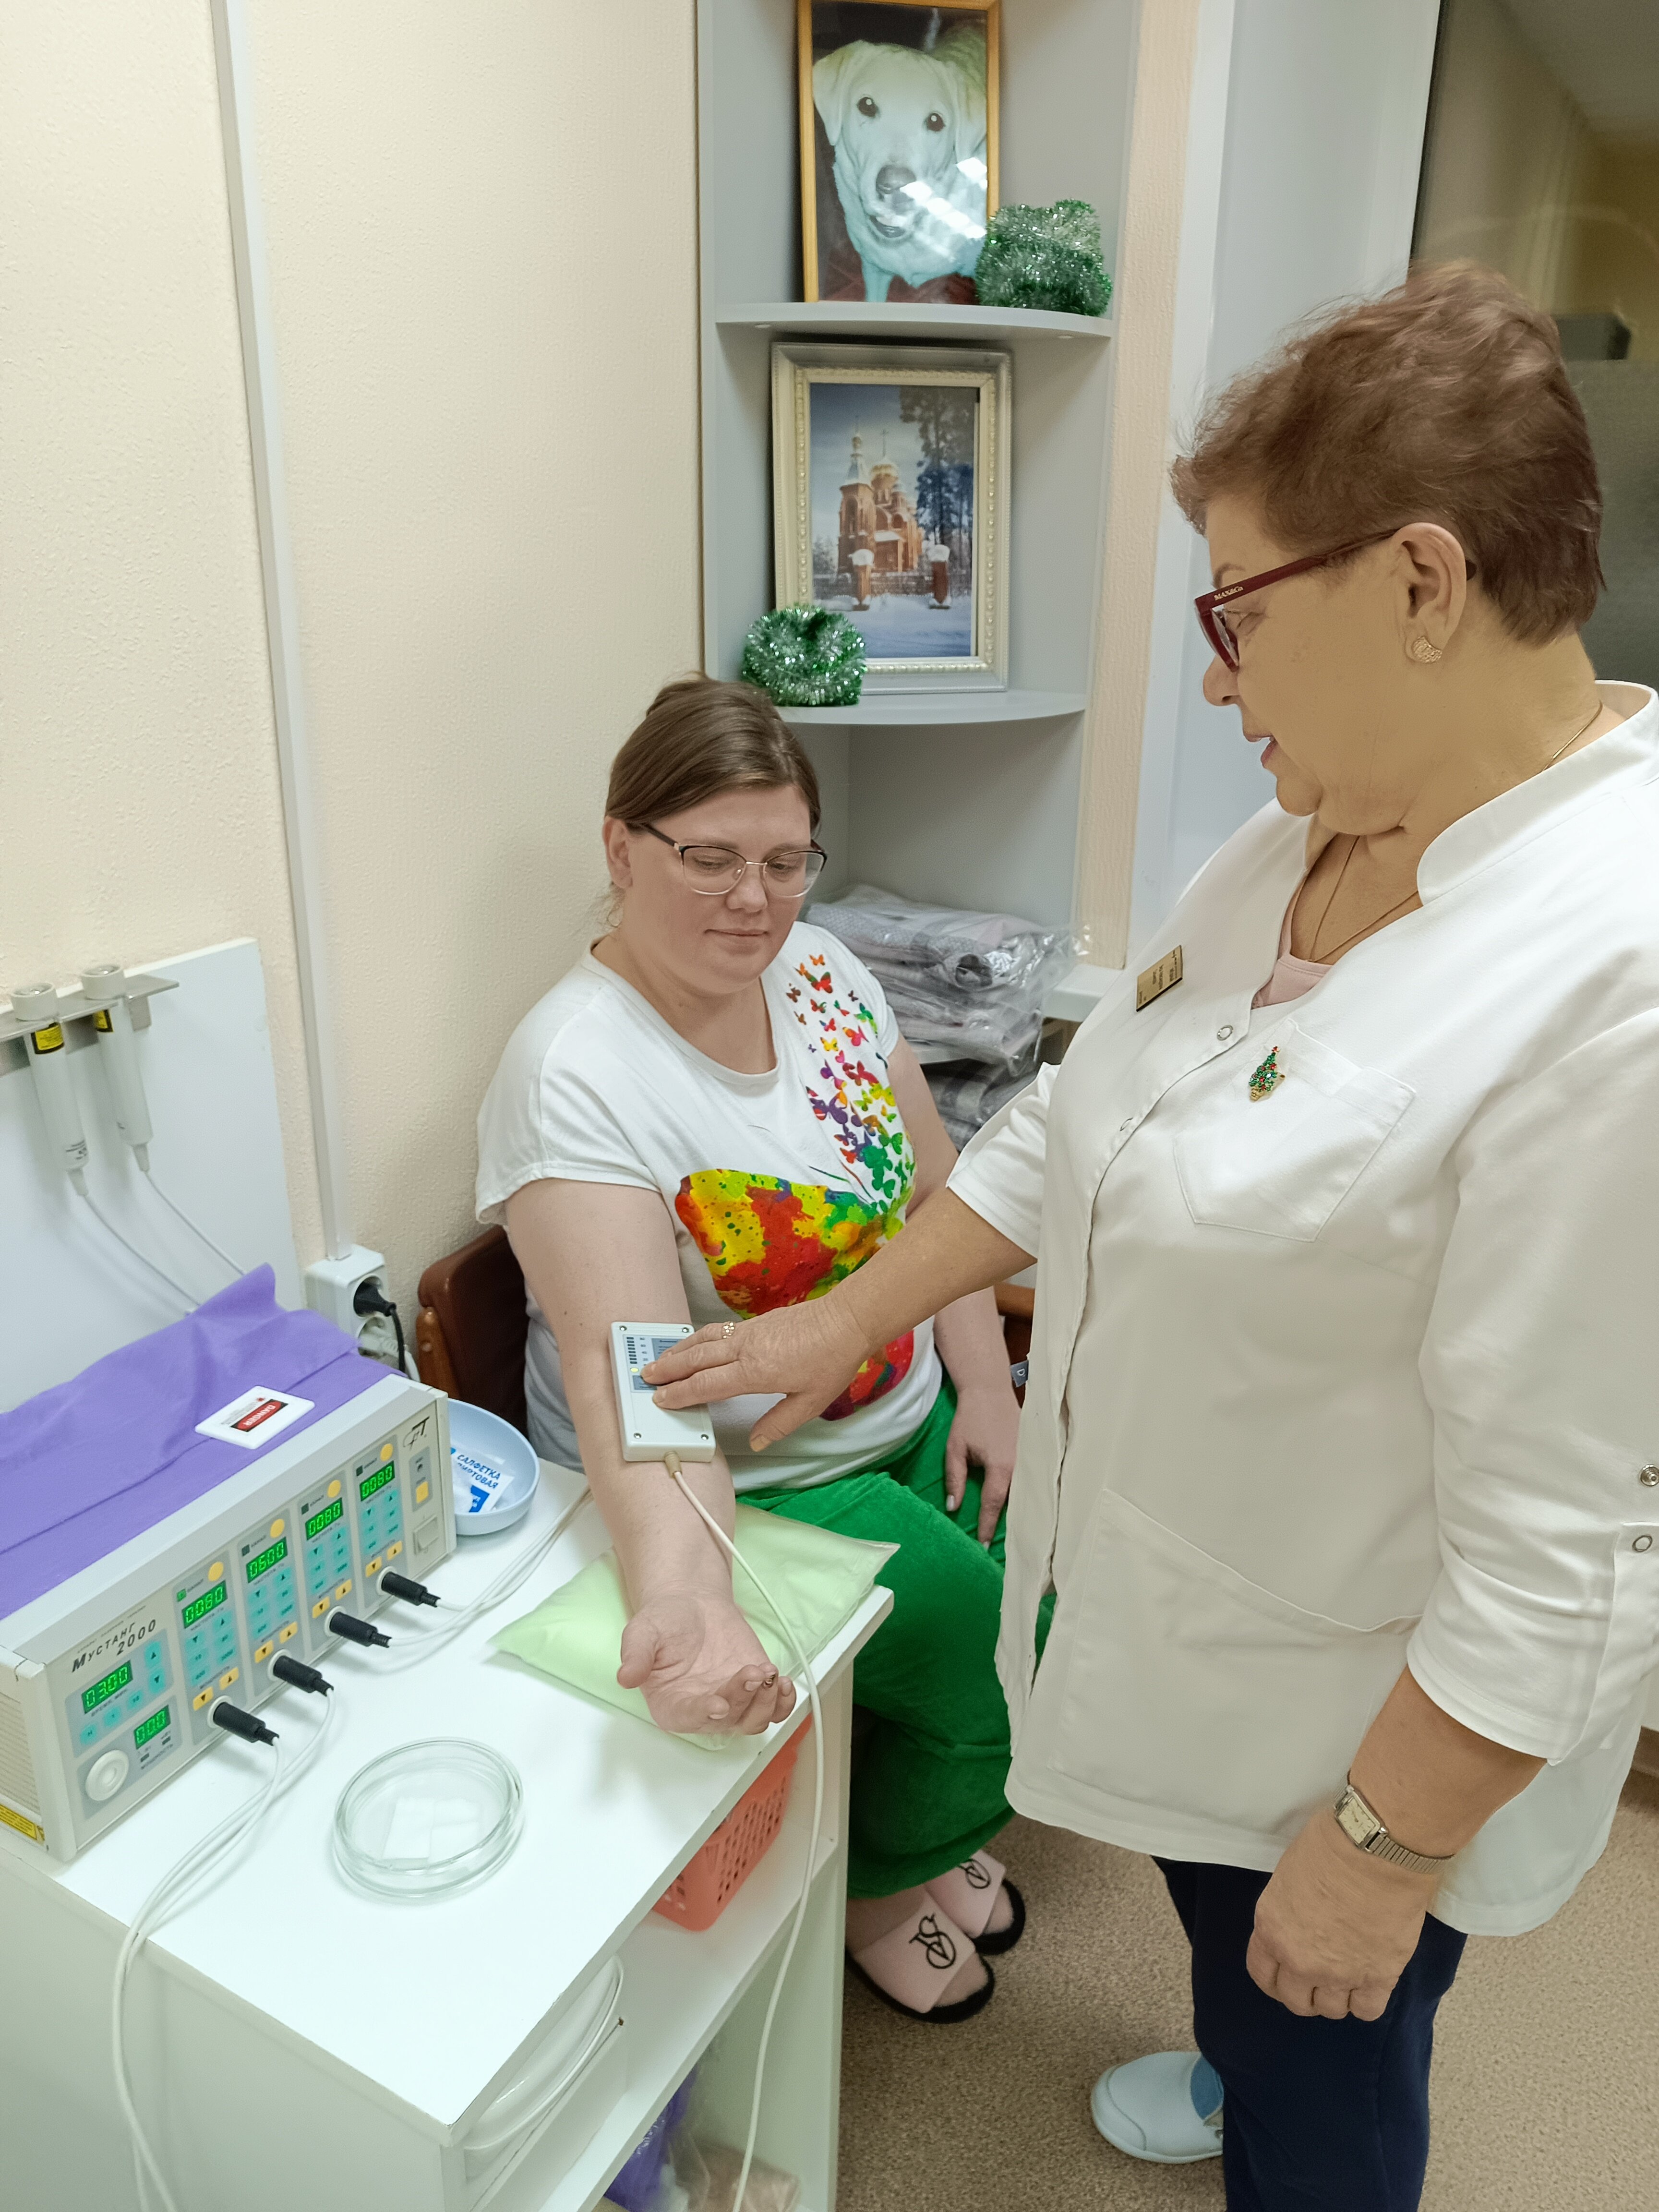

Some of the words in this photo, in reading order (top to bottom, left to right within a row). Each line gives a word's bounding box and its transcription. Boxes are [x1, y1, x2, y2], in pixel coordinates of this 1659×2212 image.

[242, 1404, 276, 1426] DANGER
[457, 1455, 501, 1479] САЛФЕТКА
[309, 1503, 340, 1536] 0080
[250, 1542, 284, 1578] 0600
[117, 1619, 156, 1656] 2000
